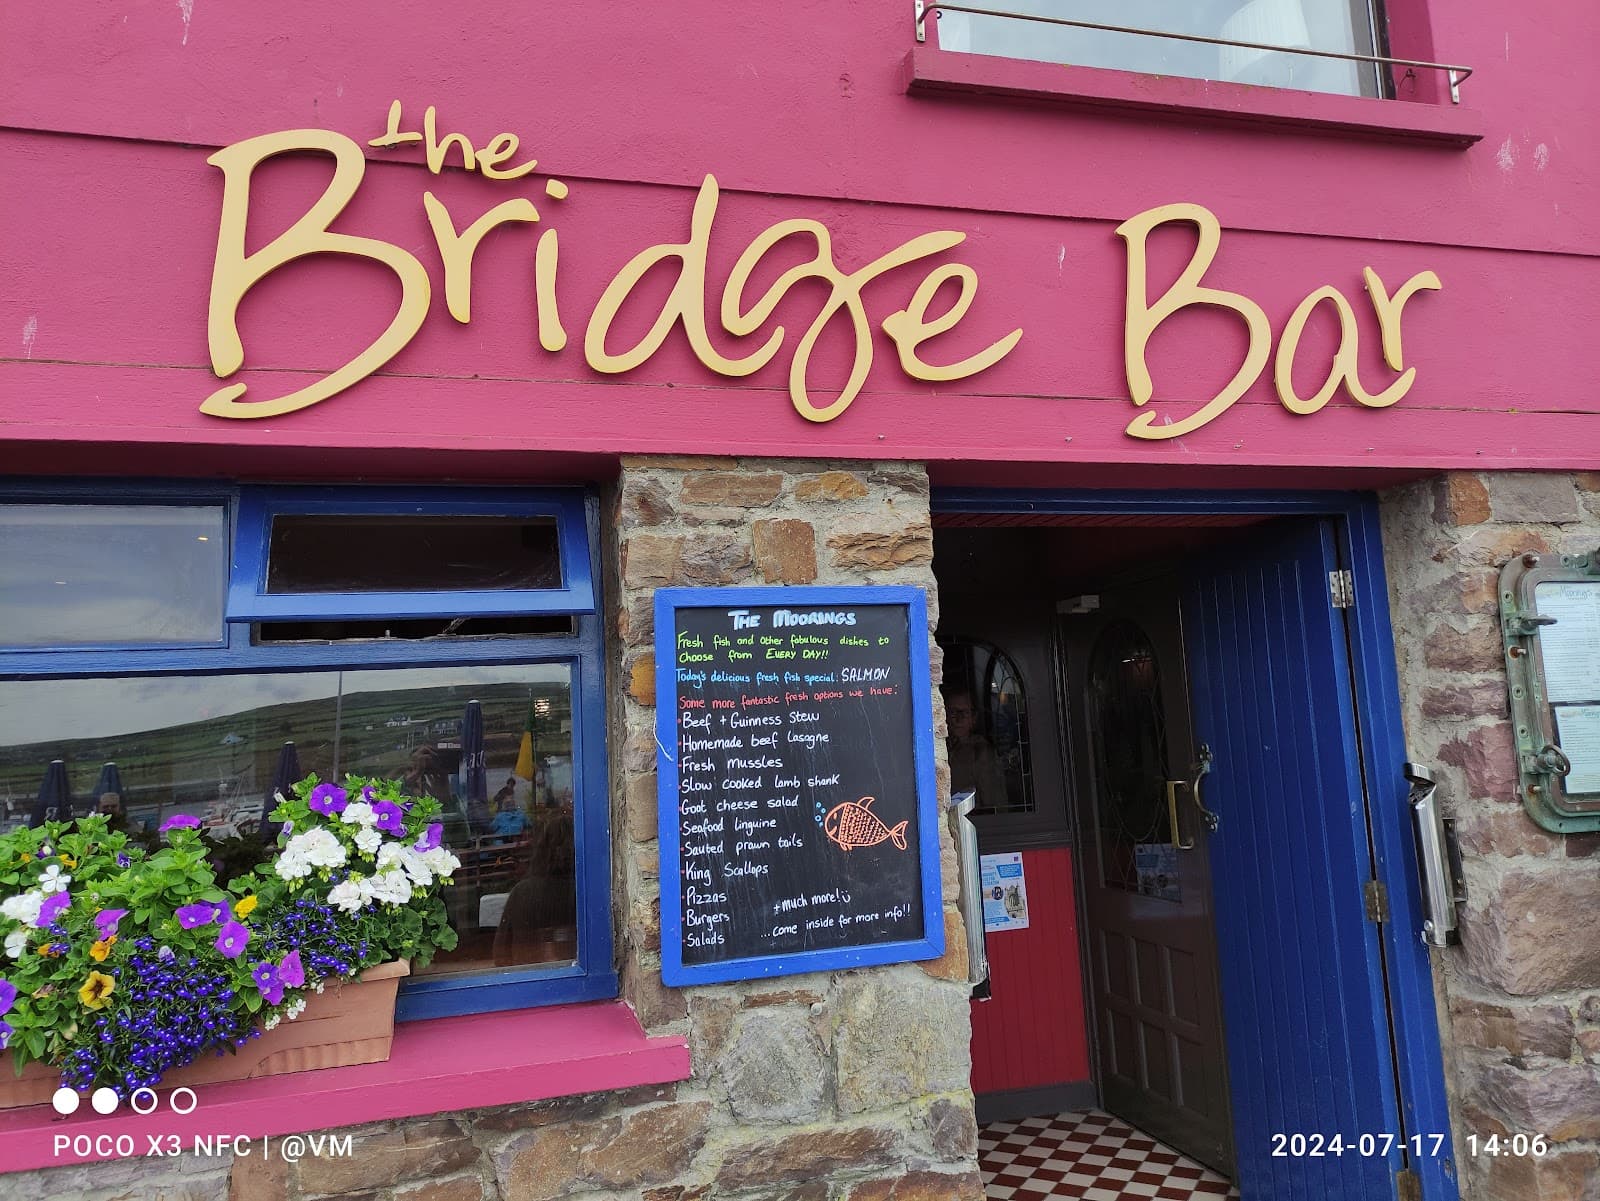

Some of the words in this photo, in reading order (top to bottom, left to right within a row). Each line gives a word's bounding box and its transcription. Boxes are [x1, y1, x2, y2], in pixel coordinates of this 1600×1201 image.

[368, 99, 538, 180] the
[199, 128, 1024, 423] Bridge
[1114, 203, 1443, 441] Bar
[677, 630, 704, 650] Fresh
[713, 634, 731, 650] fish
[737, 633, 754, 645] and
[790, 633, 829, 648] fabulous
[839, 636, 869, 646] dishes
[878, 637, 889, 645] to
[728, 649, 753, 663] from
[765, 647, 797, 660] EVERY
[802, 649, 829, 660] DAY!!
[675, 668, 706, 689] Today's
[711, 669, 750, 683] delicious
[756, 671, 779, 686] fresh
[784, 671, 800, 684] fish
[841, 666, 891, 682] SALMON
[680, 695, 705, 710] Some
[712, 699, 736, 709] more
[741, 694, 780, 710] fantastic
[785, 691, 809, 706] fresh
[814, 689, 844, 702] options
[870, 683, 898, 696] have:
[682, 711, 712, 734] Beef
[720, 715, 727, 725] +
[730, 711, 783, 729] Guinness
[682, 734, 744, 753] Homemade
[751, 731, 778, 750] beef
[682, 755, 716, 774] Fresh
[681, 776, 713, 794] Slow
[774, 774, 801, 789] lamb
[681, 799, 708, 816] Goat
[716, 799, 759, 813] cheese
[767, 794, 799, 808] salad
[682, 816, 725, 837] Seafood
[734, 816, 777, 837] linguine
[684, 840, 725, 857] Sauted
[735, 841, 770, 856] prawn
[778, 833, 804, 849] tails
[685, 860, 712, 887] King
[686, 885, 728, 906] Pizzas
[686, 908, 731, 932] Burgers
[805, 916, 835, 931] inside
[838, 913, 853, 929] for
[855, 910, 880, 924] more
[884, 903, 911, 923] info!!
[686, 931, 726, 949] Salads
